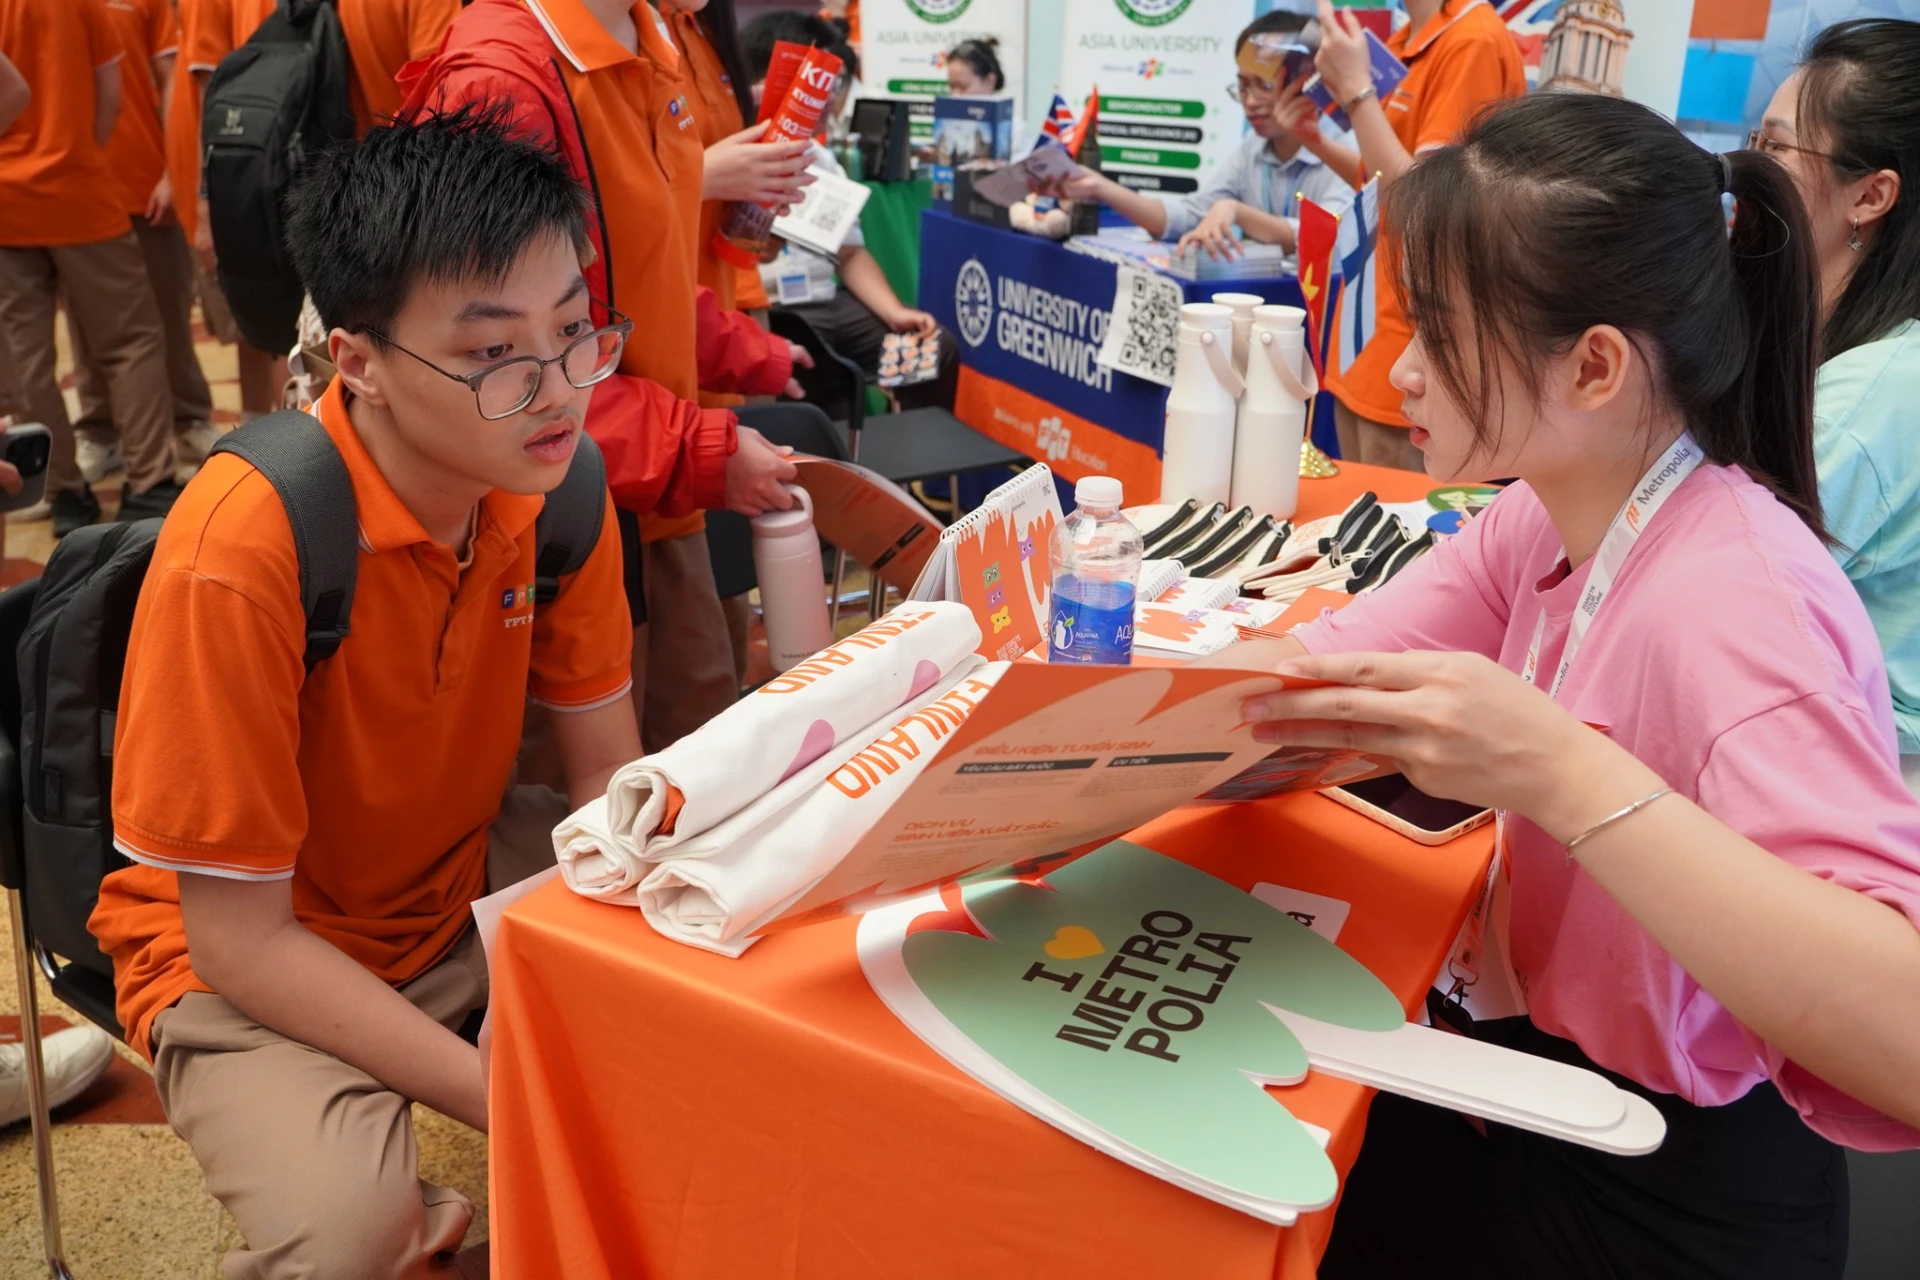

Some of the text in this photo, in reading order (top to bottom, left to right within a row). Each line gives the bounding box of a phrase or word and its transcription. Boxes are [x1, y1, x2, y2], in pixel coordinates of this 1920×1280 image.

[1079, 33, 1221, 52] ASIA UNIVERSITY
[1107, 100, 1183, 114] SEMICONDUCTOR
[781, 118, 799, 135] 03
[1120, 149, 1159, 163] FINANCE
[1118, 174, 1161, 189] BUSINESS
[998, 275, 1090, 338] UNIVERSITY
[996, 310, 1112, 393] GREENWICH
[1637, 447, 1691, 506] Metropolia
[1588, 591, 1604, 617] FUTURE
[504, 615, 527, 628] FPT
[1075, 631, 1100, 640] AQUAFINA
[1114, 623, 1134, 645] AQU
[826, 678, 993, 799] FINLAND
[893, 831, 936, 842] SINH
[1022, 961, 1084, 993] I
[1055, 910, 1193, 1052] METRO
[1123, 931, 1253, 1063] POLIA
